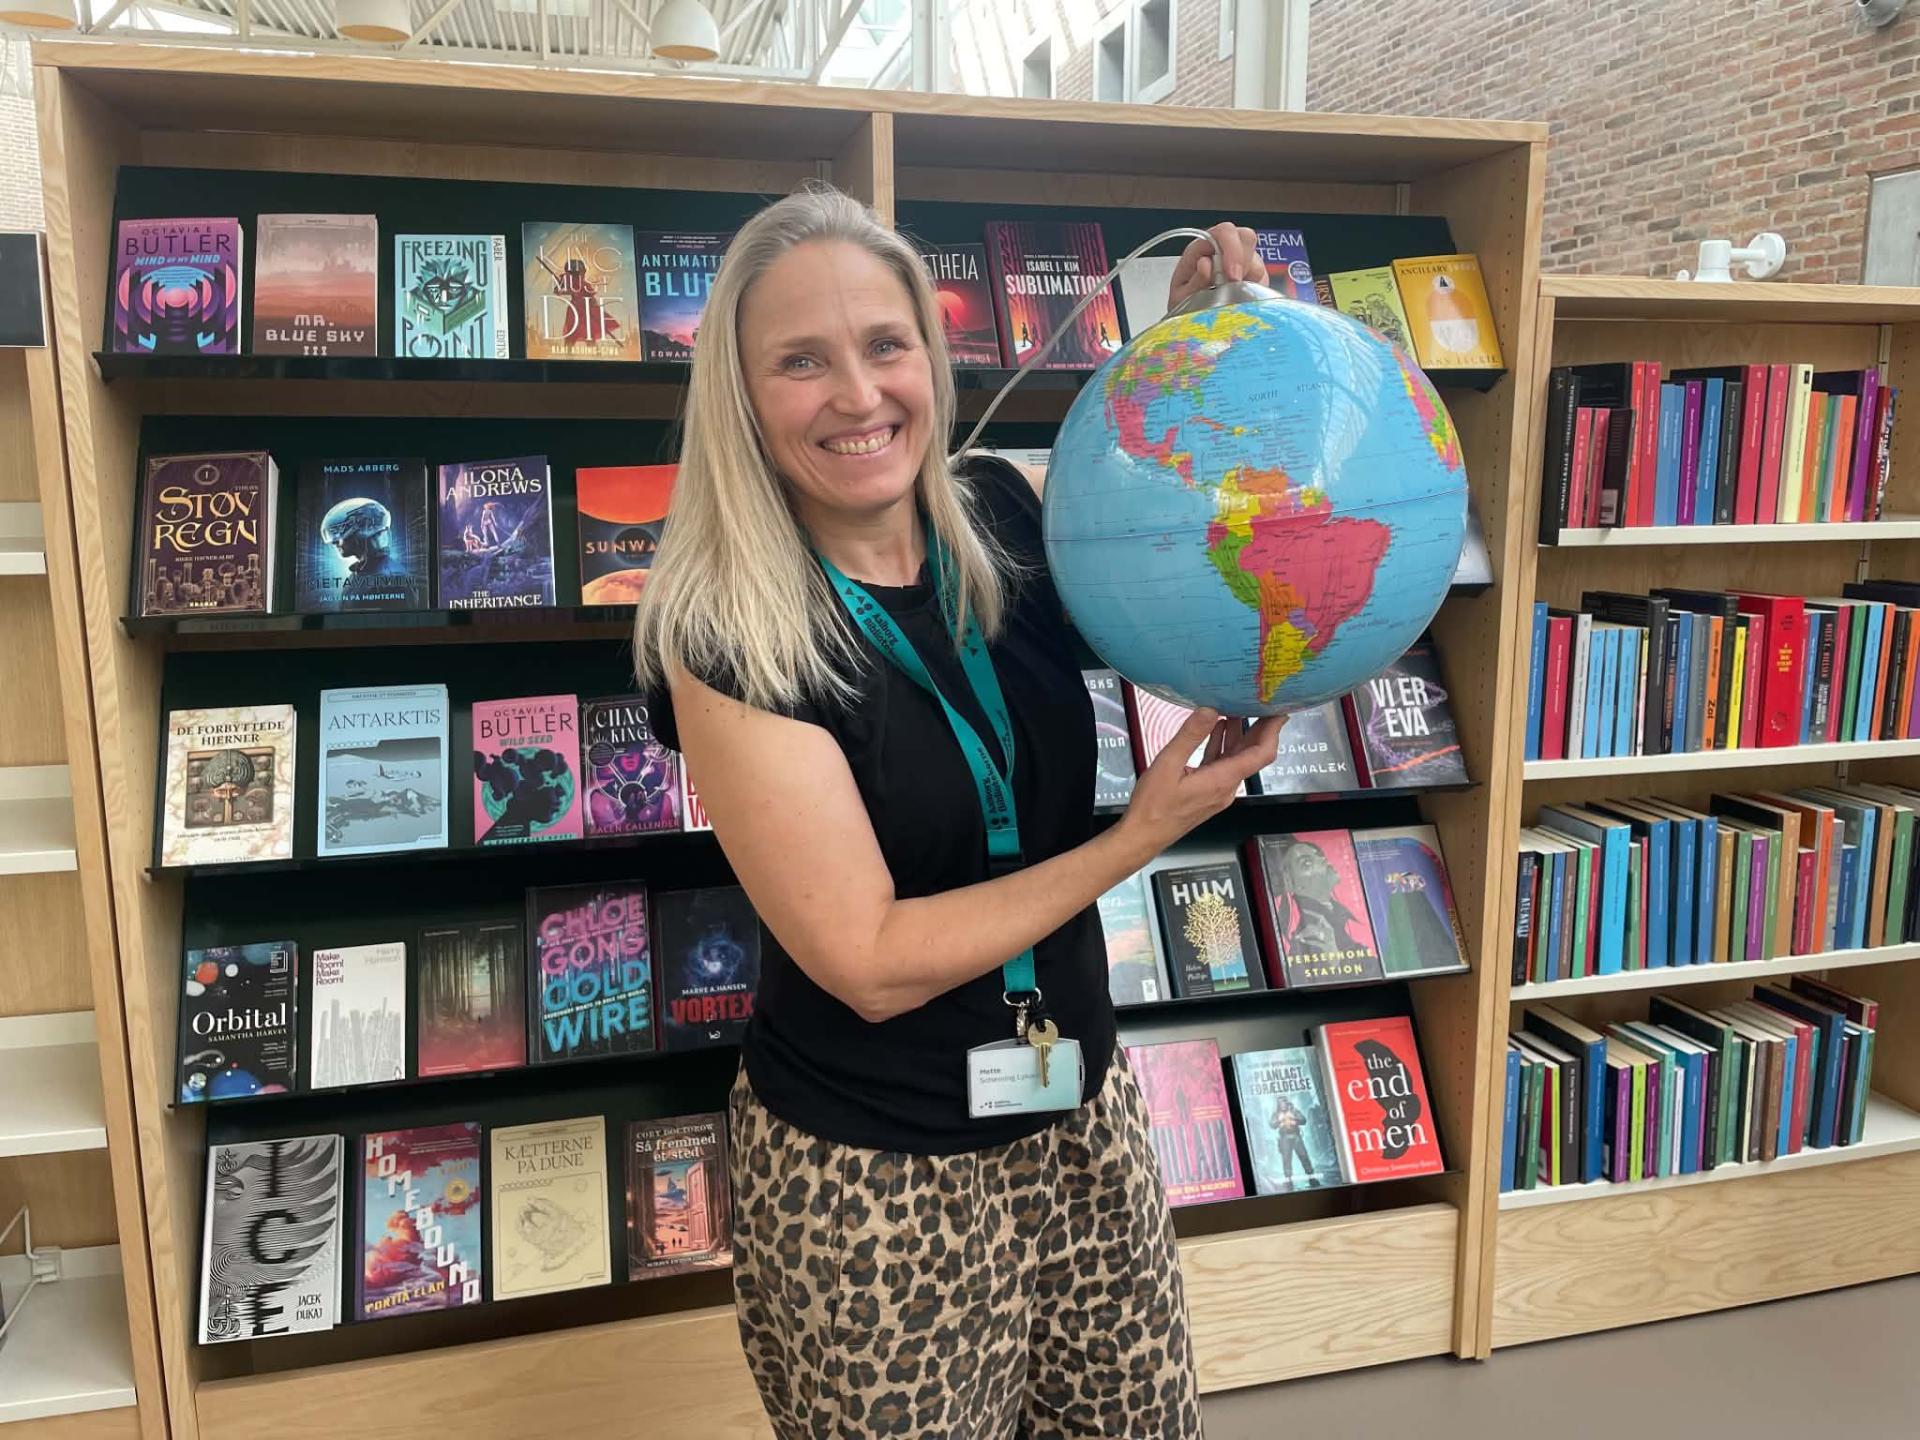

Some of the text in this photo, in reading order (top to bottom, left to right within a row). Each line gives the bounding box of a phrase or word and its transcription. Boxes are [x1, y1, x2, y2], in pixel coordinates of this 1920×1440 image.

[142, 226, 200, 236] OCTAVIA
[125, 234, 231, 256] BUTLER
[134, 255, 166, 266] MIND
[190, 254, 221, 264] MIND
[401, 240, 488, 289] FREEZING
[539, 245, 623, 272] KING
[1026, 261, 1055, 273] ISABEL
[1064, 260, 1080, 273] KIM
[551, 274, 609, 293] MUST
[1004, 274, 1109, 296] SUBLIMATION
[294, 314, 335, 327] MR.
[541, 295, 626, 341] DIE
[265, 329, 366, 343] BLUE SKY
[401, 312, 488, 358] POINT
[1249, 390, 1279, 402] NORTH
[323, 464, 400, 473] MADS ARBERG
[463, 467, 524, 485] ILONA
[446, 479, 543, 500] ANDREWS
[155, 487, 259, 523] STØV
[154, 519, 258, 553] REGN
[449, 594, 543, 609] INHERITANCE
[472, 590, 491, 598] THE
[1370, 677, 1430, 708] VI ER
[328, 708, 441, 731] ANTARKTIS
[494, 706, 545, 718] OCTAVIA
[177, 721, 286, 736] DE FORBYTTEDE
[480, 713, 574, 738] BUTLER
[1383, 707, 1430, 737] EVA
[201, 733, 260, 746] HJERNER
[1278, 742, 1328, 756] JAKUB
[1266, 762, 1347, 777] SZAMALEK
[1172, 878, 1235, 906] HUM
[541, 894, 645, 941] CHLOE
[541, 927, 647, 975] GONG
[1287, 949, 1373, 967] PERSEPHONE
[1304, 964, 1363, 978] STATION
[544, 960, 649, 1011] COLD
[671, 992, 755, 1025] VORTEX
[192, 1003, 287, 1035] Orbital
[544, 996, 650, 1052] WIRE
[208, 1027, 288, 1043] SAMANTHA HARVEY
[1367, 1053, 1393, 1070] the
[1253, 1066, 1303, 1083] PLANLAGT
[1347, 1063, 1413, 1100] end
[1250, 1078, 1313, 1096] FORÆLDELSE
[1389, 1101, 1407, 1119] of
[636, 1122, 715, 1139] CORY DOCTOROW
[1350, 1122, 1429, 1153] men
[504, 1136, 593, 1161] KÆTTERNE
[635, 1133, 717, 1153] Så fremmed
[540, 1152, 585, 1172] DUNE
[653, 1147, 700, 1162] et sted
[298, 1293, 322, 1307] JACEK
[296, 1308, 323, 1321] DUKAJ
